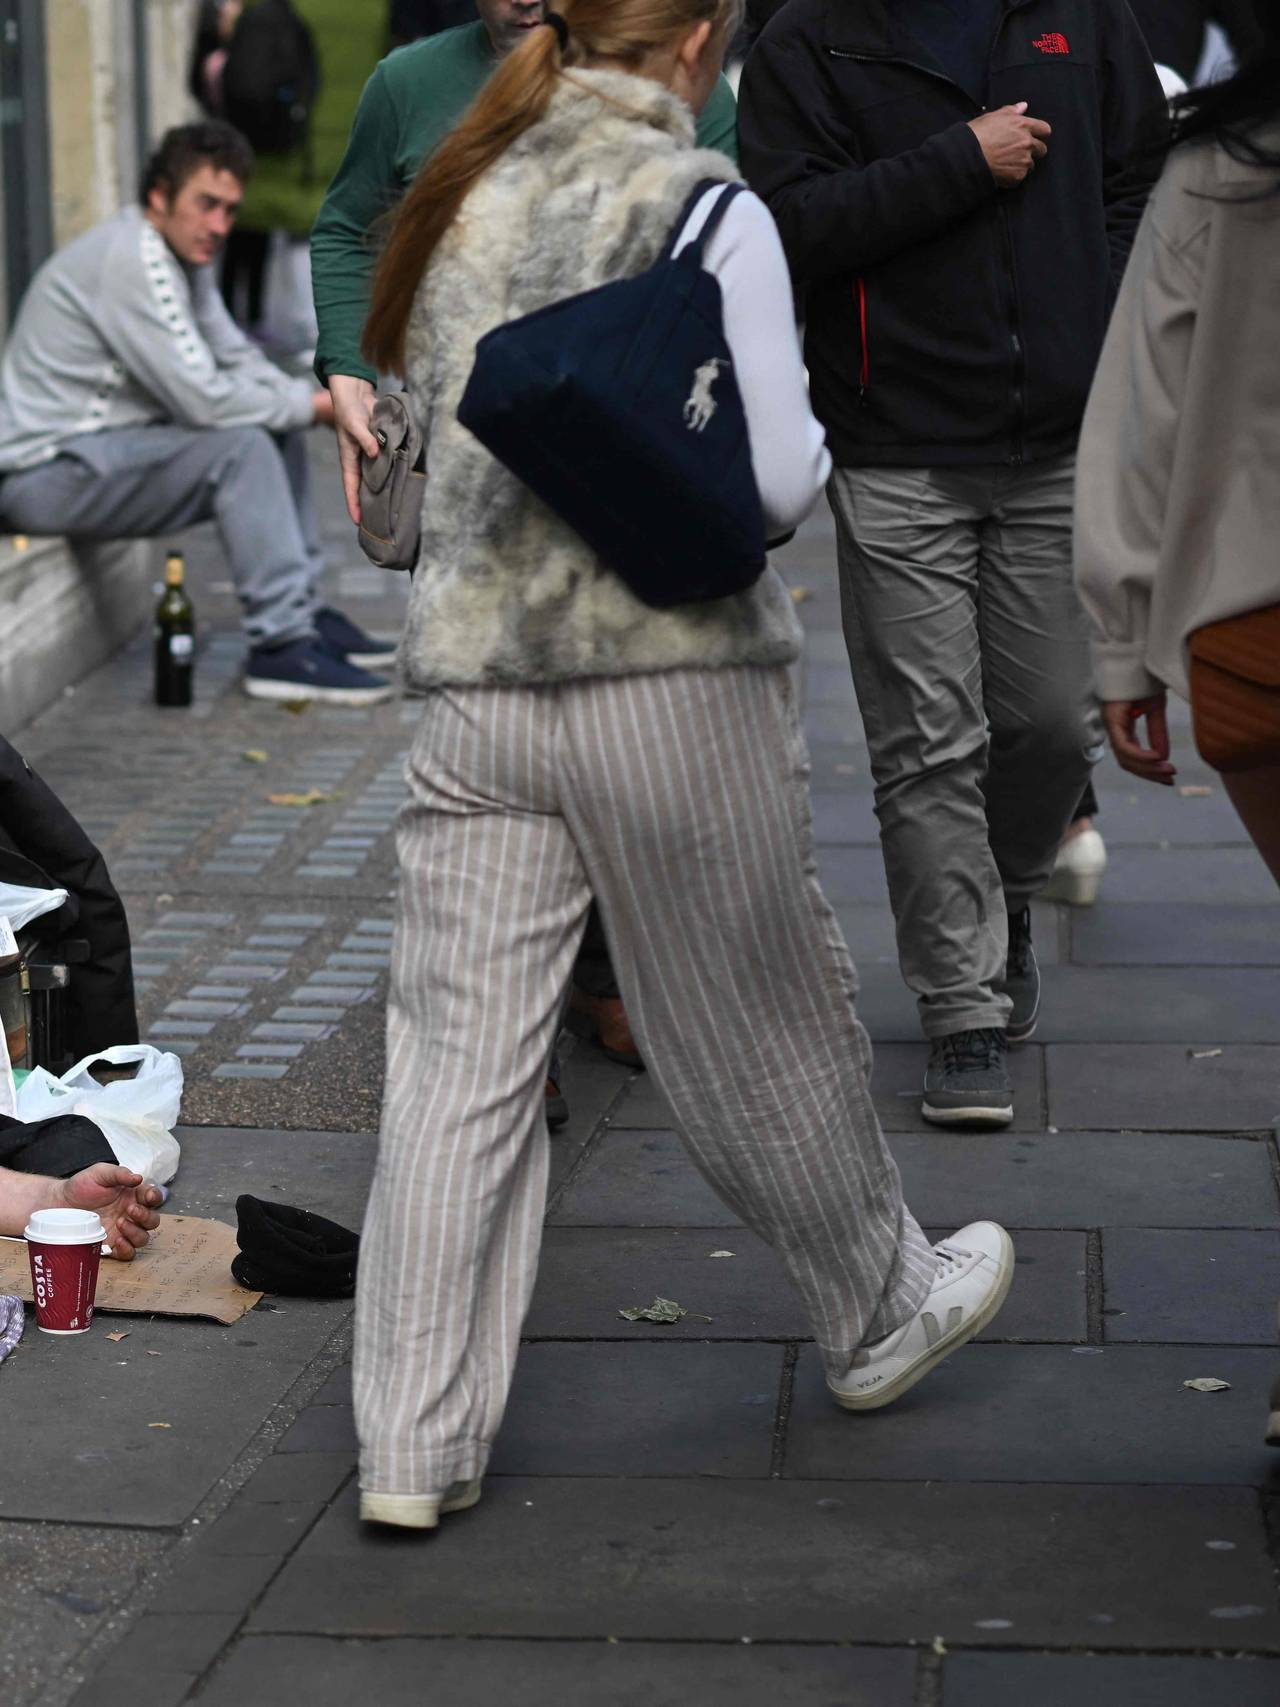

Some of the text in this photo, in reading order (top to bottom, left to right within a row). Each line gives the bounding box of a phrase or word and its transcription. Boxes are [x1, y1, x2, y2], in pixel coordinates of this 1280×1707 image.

[1032, 40, 1058, 48] NORTH
[1041, 46, 1060, 54] FACE
[34, 1255, 47, 1308] COSTA
[46, 1268, 55, 1298] COFFEE
[857, 1375, 884, 1389] VEJA
